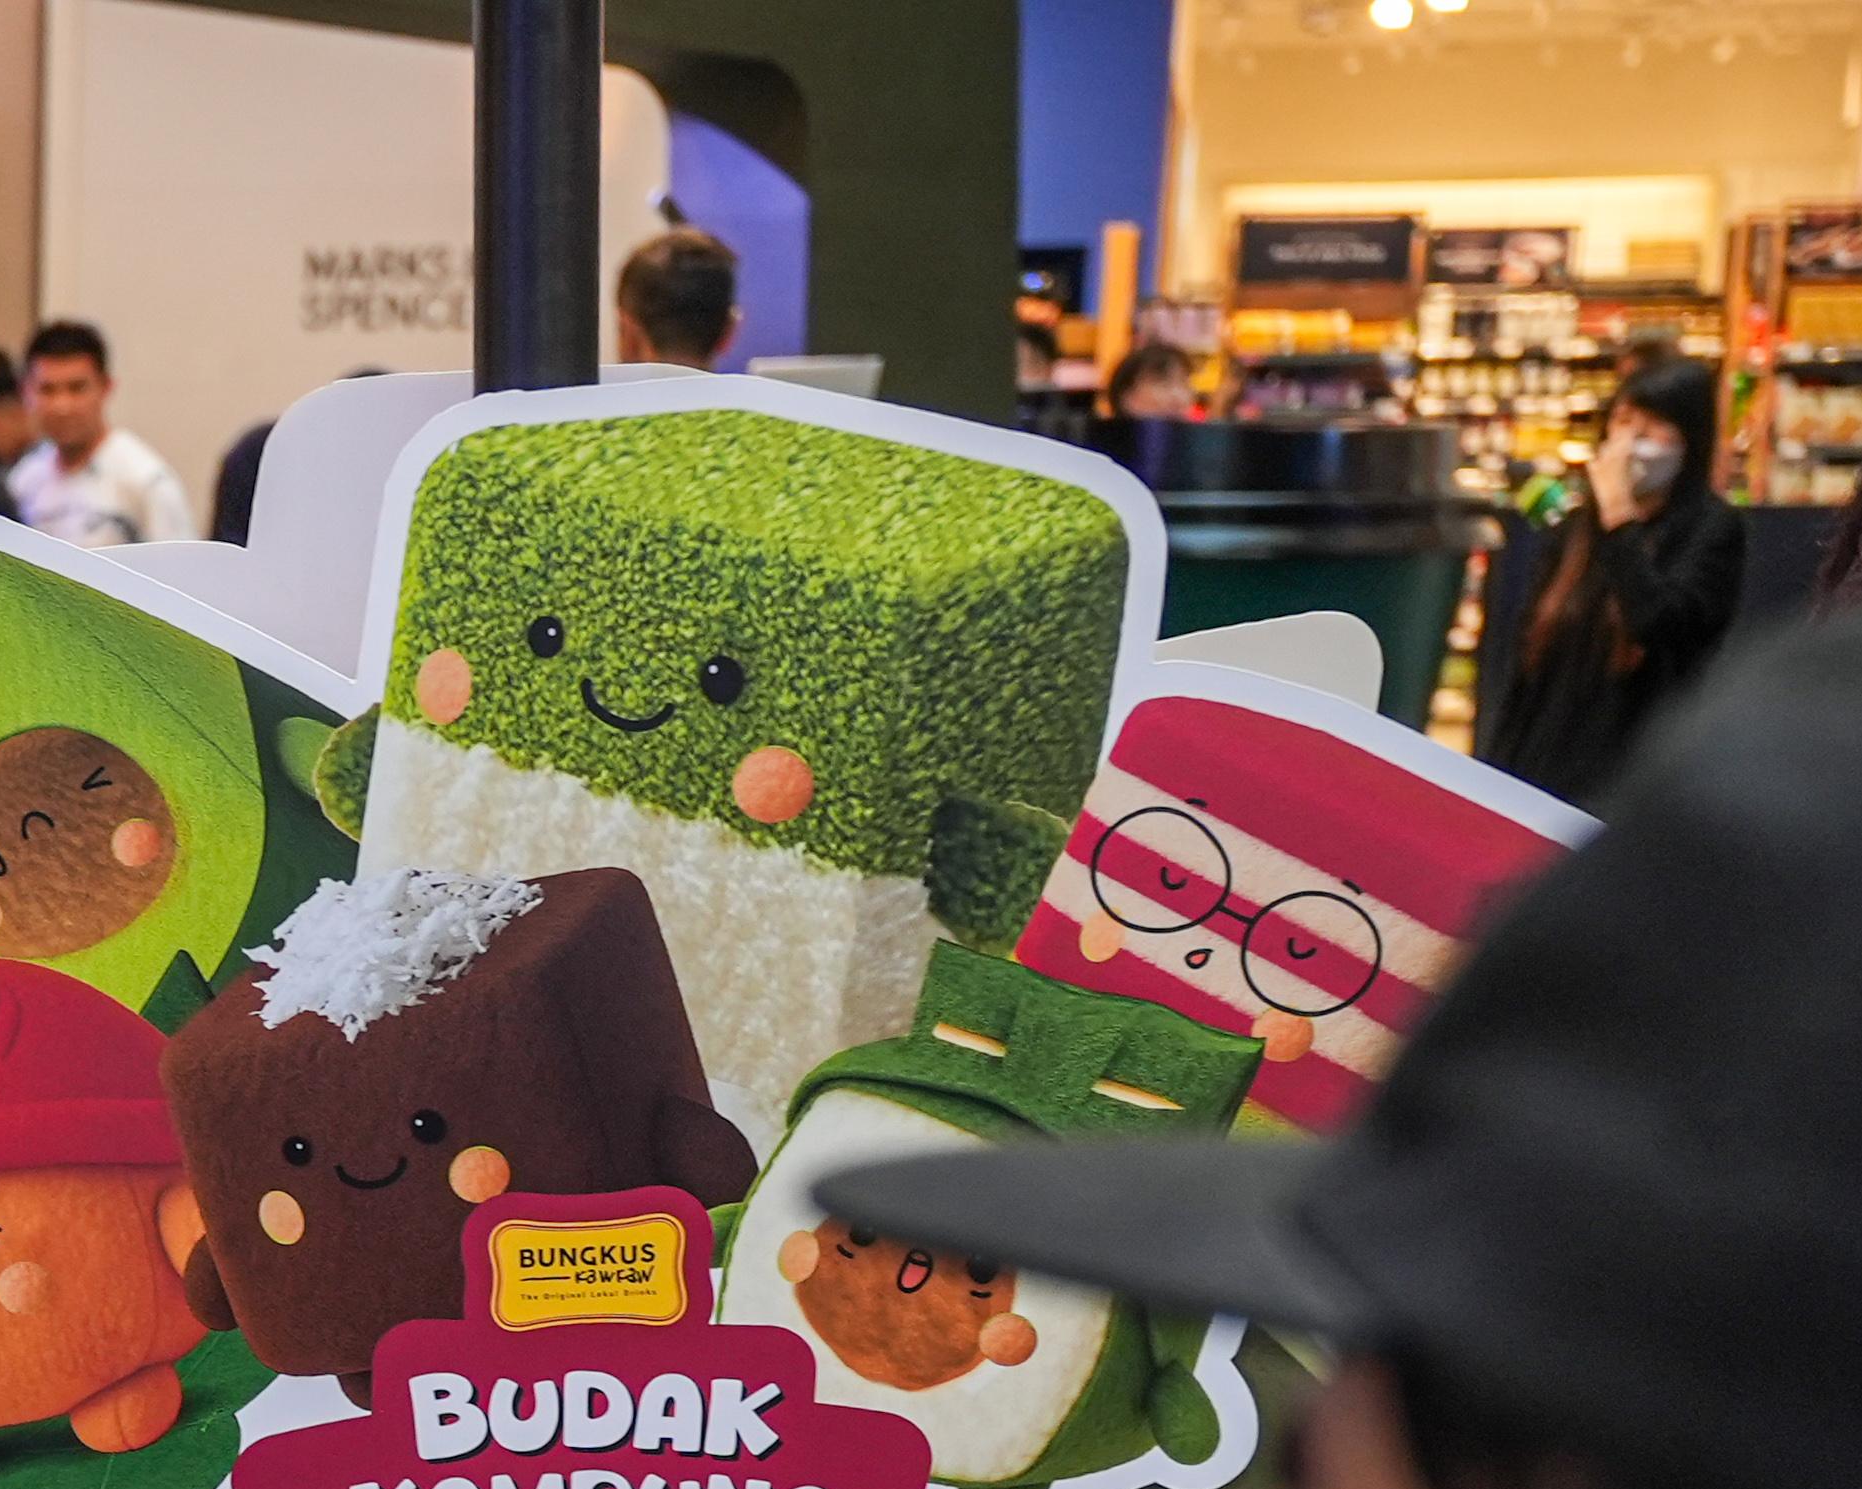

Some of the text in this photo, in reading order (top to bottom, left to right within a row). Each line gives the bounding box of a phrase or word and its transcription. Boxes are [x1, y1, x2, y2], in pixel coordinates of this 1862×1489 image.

[301, 294, 467, 331] SPENCE
[519, 1243, 656, 1269] BUNGKUS
[409, 1370, 783, 1461] BUDAK
